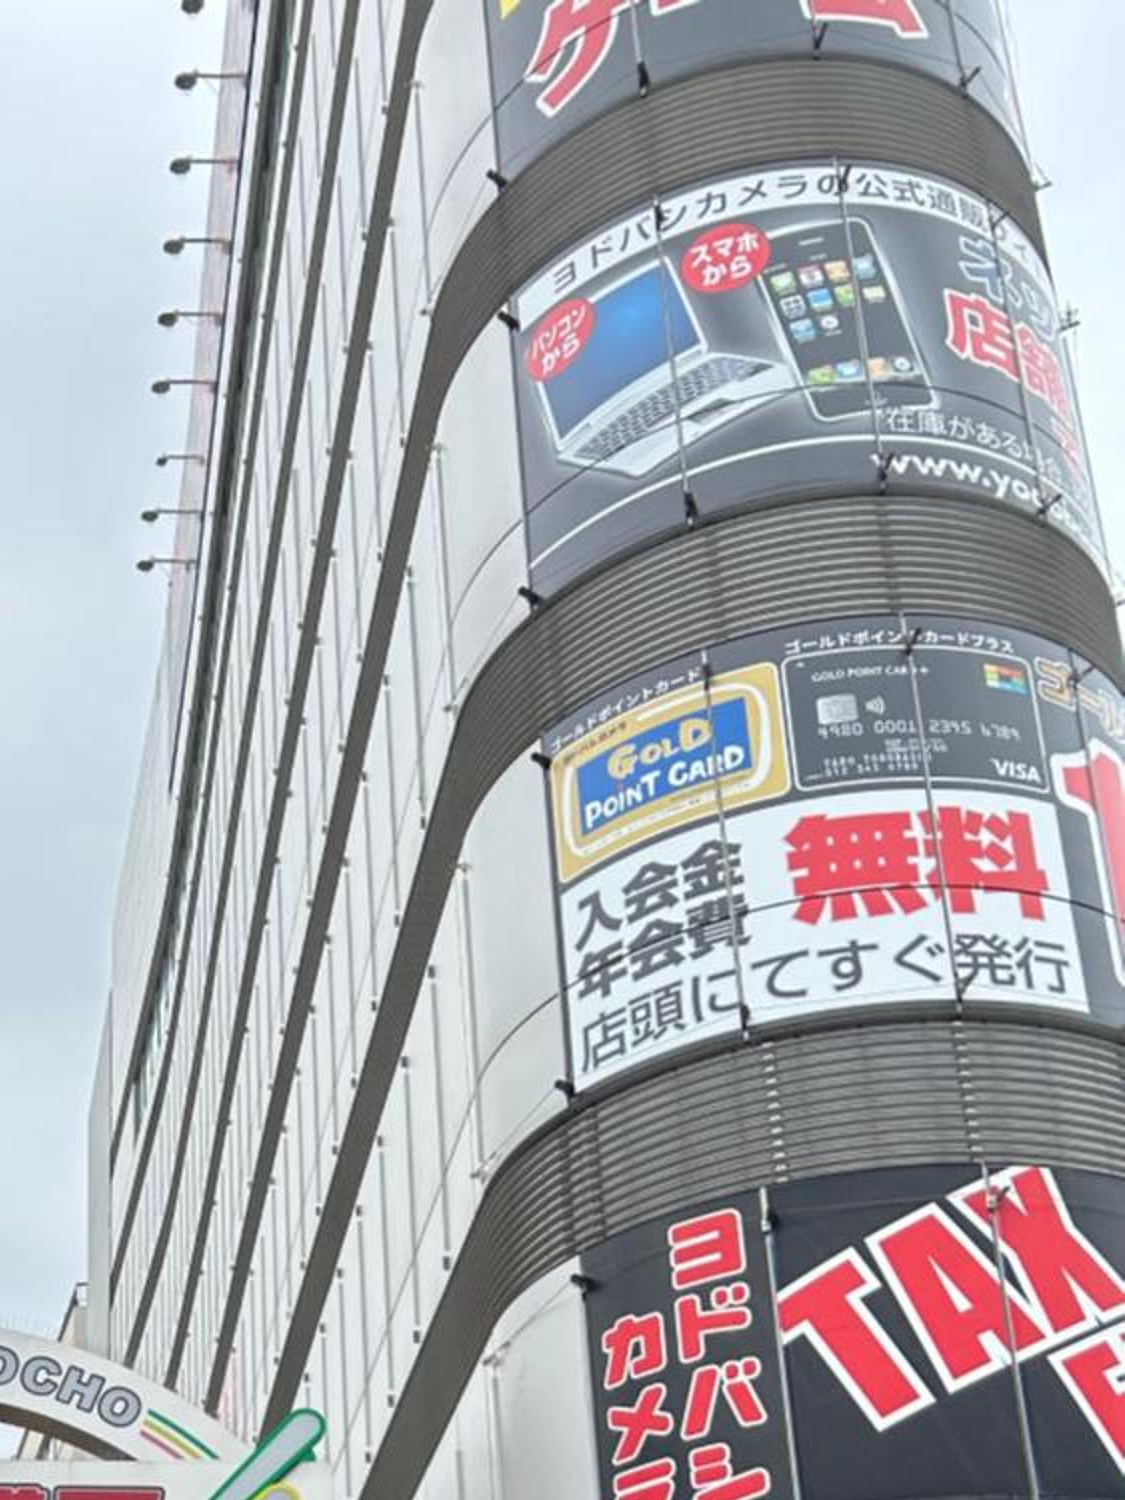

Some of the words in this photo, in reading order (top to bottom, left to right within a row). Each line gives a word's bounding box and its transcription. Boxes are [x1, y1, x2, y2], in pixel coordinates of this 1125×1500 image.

[690, 232, 760, 268] スマホ
[701, 253, 752, 288] から
[530, 304, 587, 358] パソコン
[540, 333, 580, 370] から
[811, 669, 844, 682] GOLD
[608, 719, 711, 779] GOLD
[994, 759, 1041, 783] VISA
[585, 771, 662, 829] POINT
[784, 805, 1052, 925] 無料
[576, 840, 745, 951] 入会金
[578, 904, 751, 1001] 年会費
[581, 933, 1071, 1075] 店頭にてすぐ発行
[774, 1165, 1125, 1433] TAX
